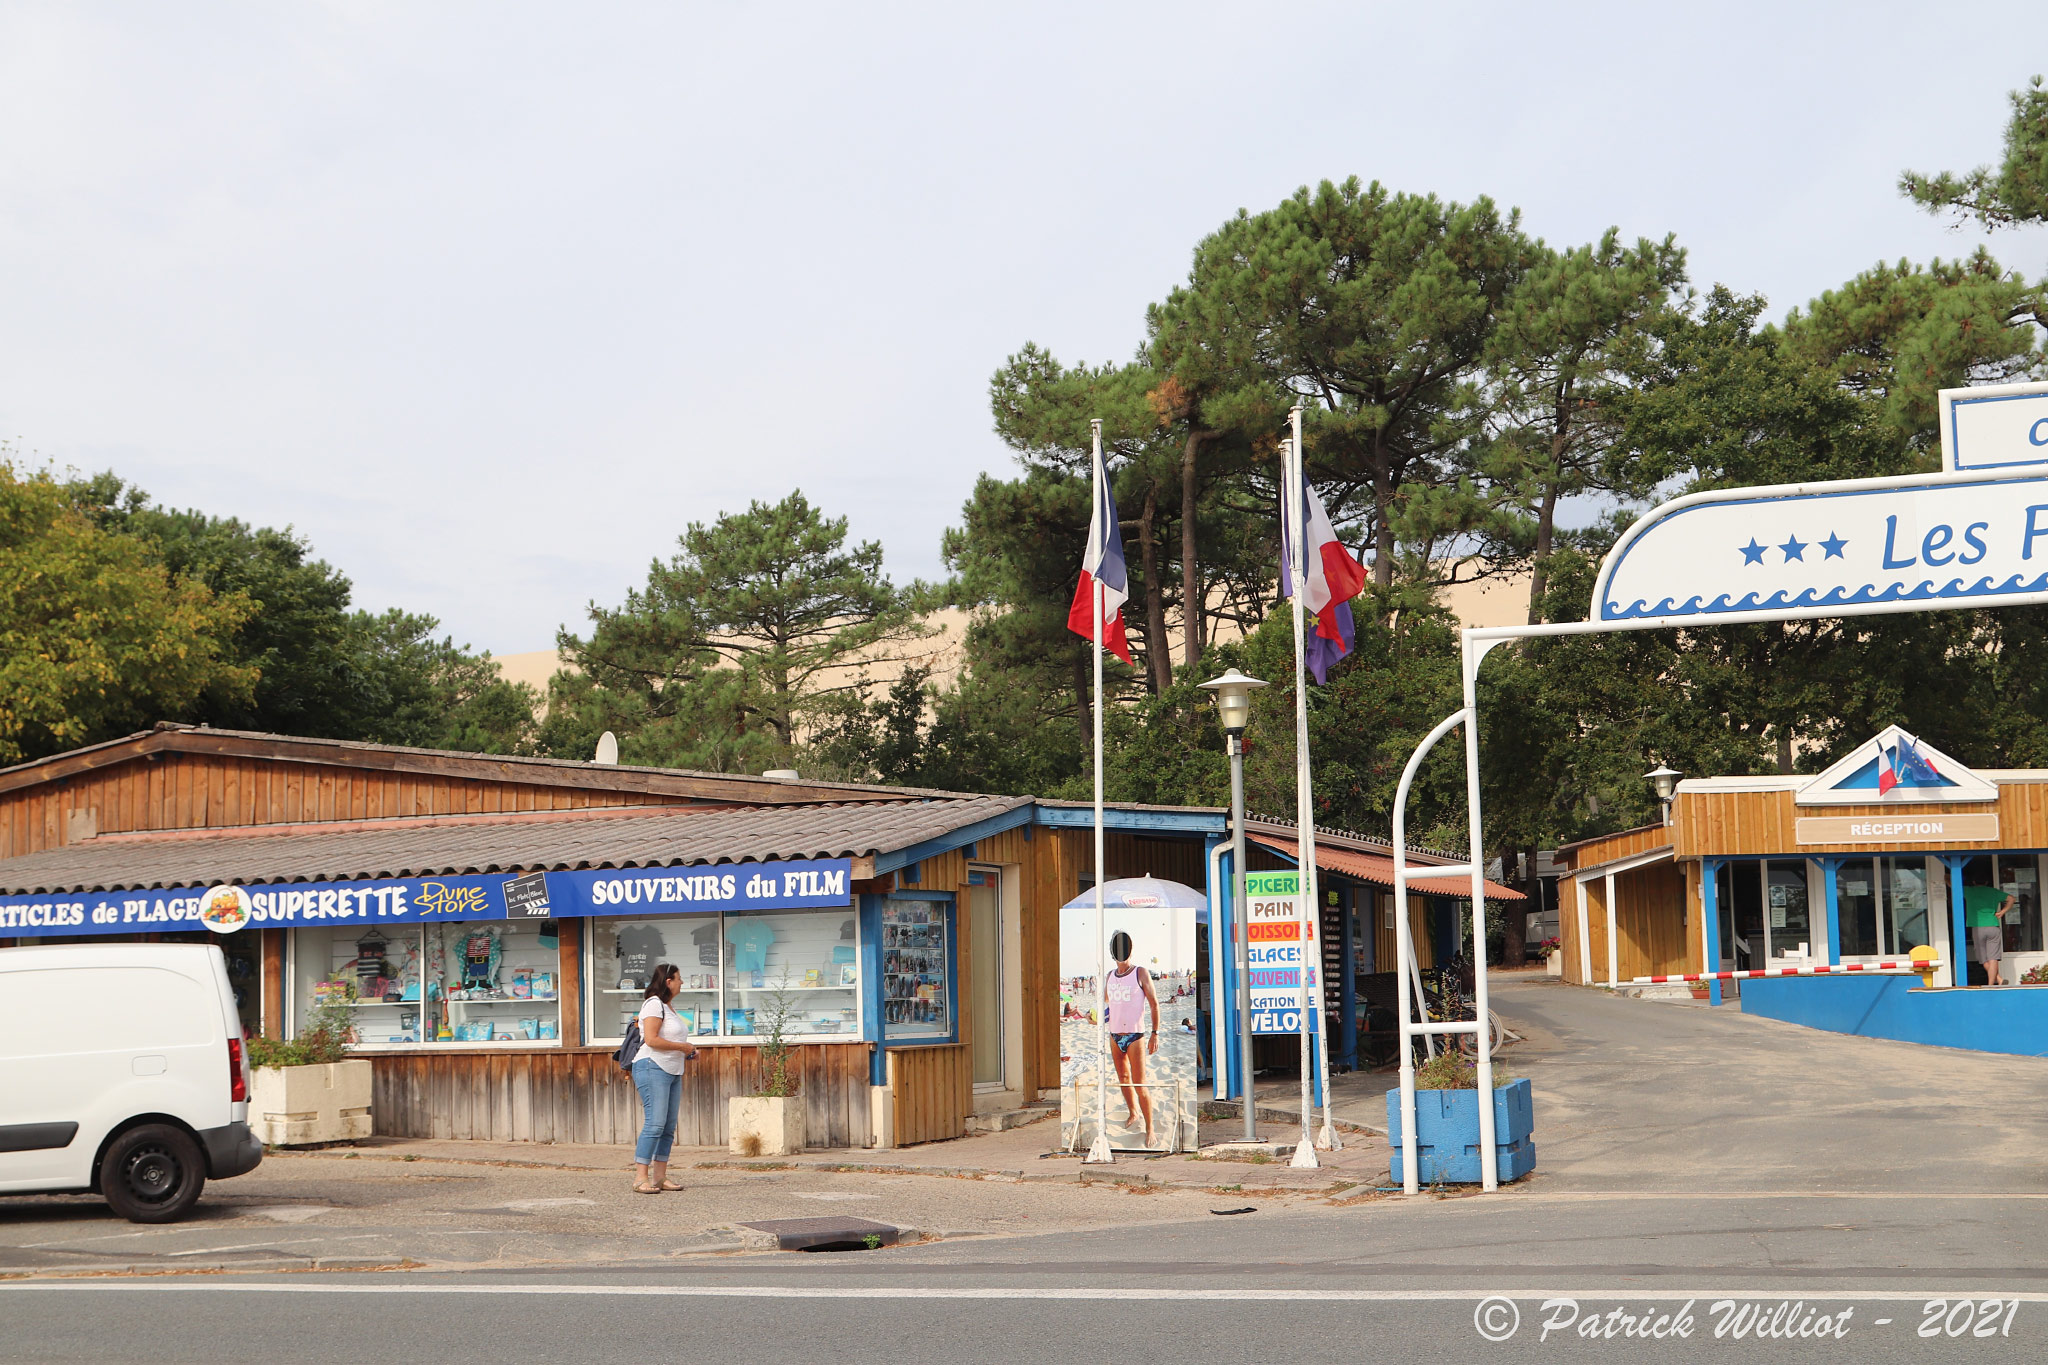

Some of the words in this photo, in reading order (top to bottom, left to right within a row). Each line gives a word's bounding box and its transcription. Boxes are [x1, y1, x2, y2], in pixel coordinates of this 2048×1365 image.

[1882, 514, 1989, 571] Les
[1850, 821, 1943, 837] RÉCEPTION
[419, 881, 487, 902] Dune
[592, 875, 736, 905] SOUVENIRS
[745, 873, 776, 899] du
[783, 869, 845, 898] FILM
[92, 901, 118, 924] de
[123, 897, 200, 923] PLAGE
[252, 886, 408, 922] SUPERETTE
[413, 896, 489, 916] Store
[1254, 901, 1293, 918] PAIN
